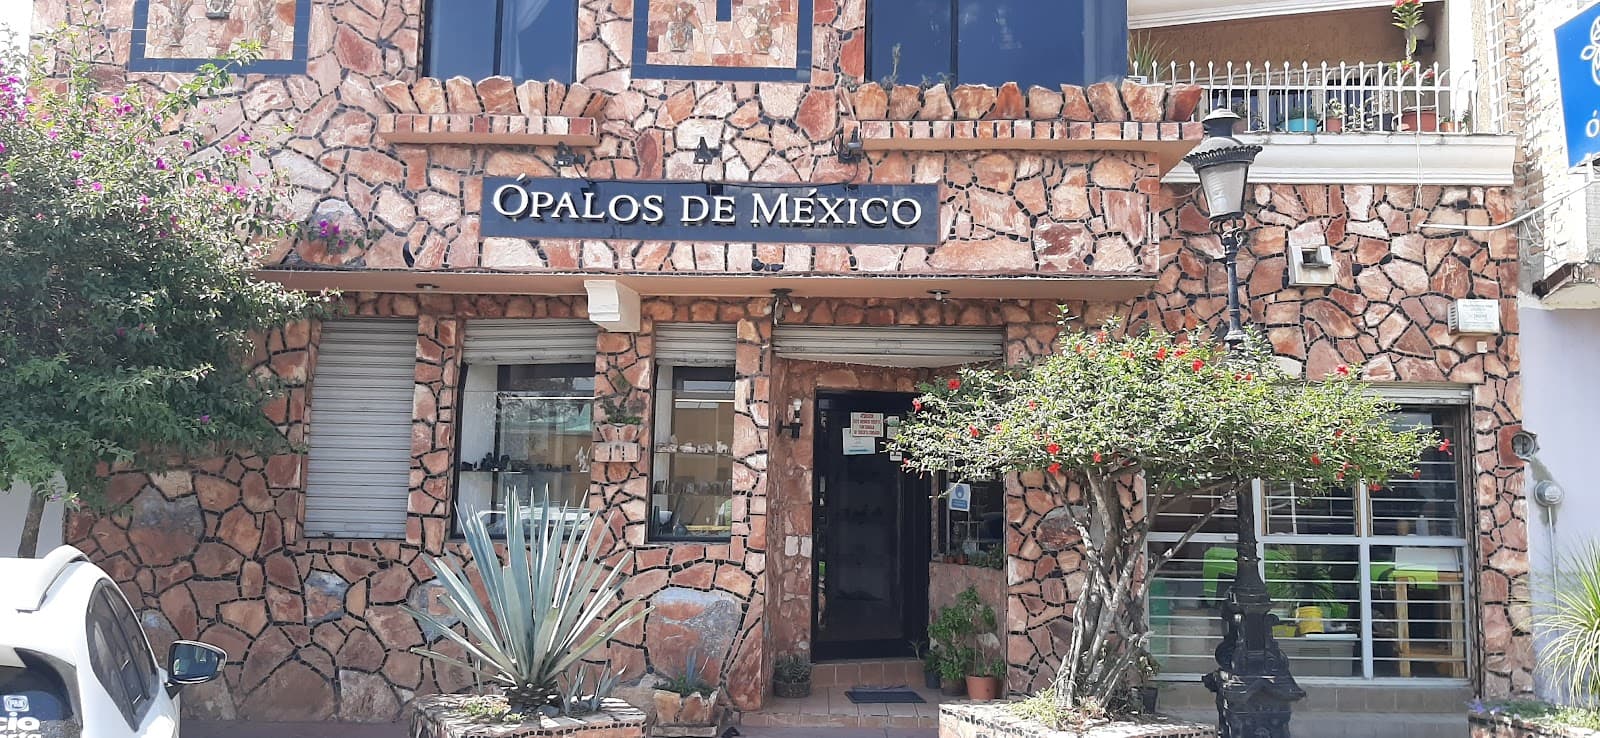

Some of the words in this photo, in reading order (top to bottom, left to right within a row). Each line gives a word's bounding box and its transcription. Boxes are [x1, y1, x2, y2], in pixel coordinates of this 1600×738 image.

[492, 173, 665, 222] ÓPALOS
[680, 195, 737, 224] DE
[751, 188, 922, 226] MÉXICO
